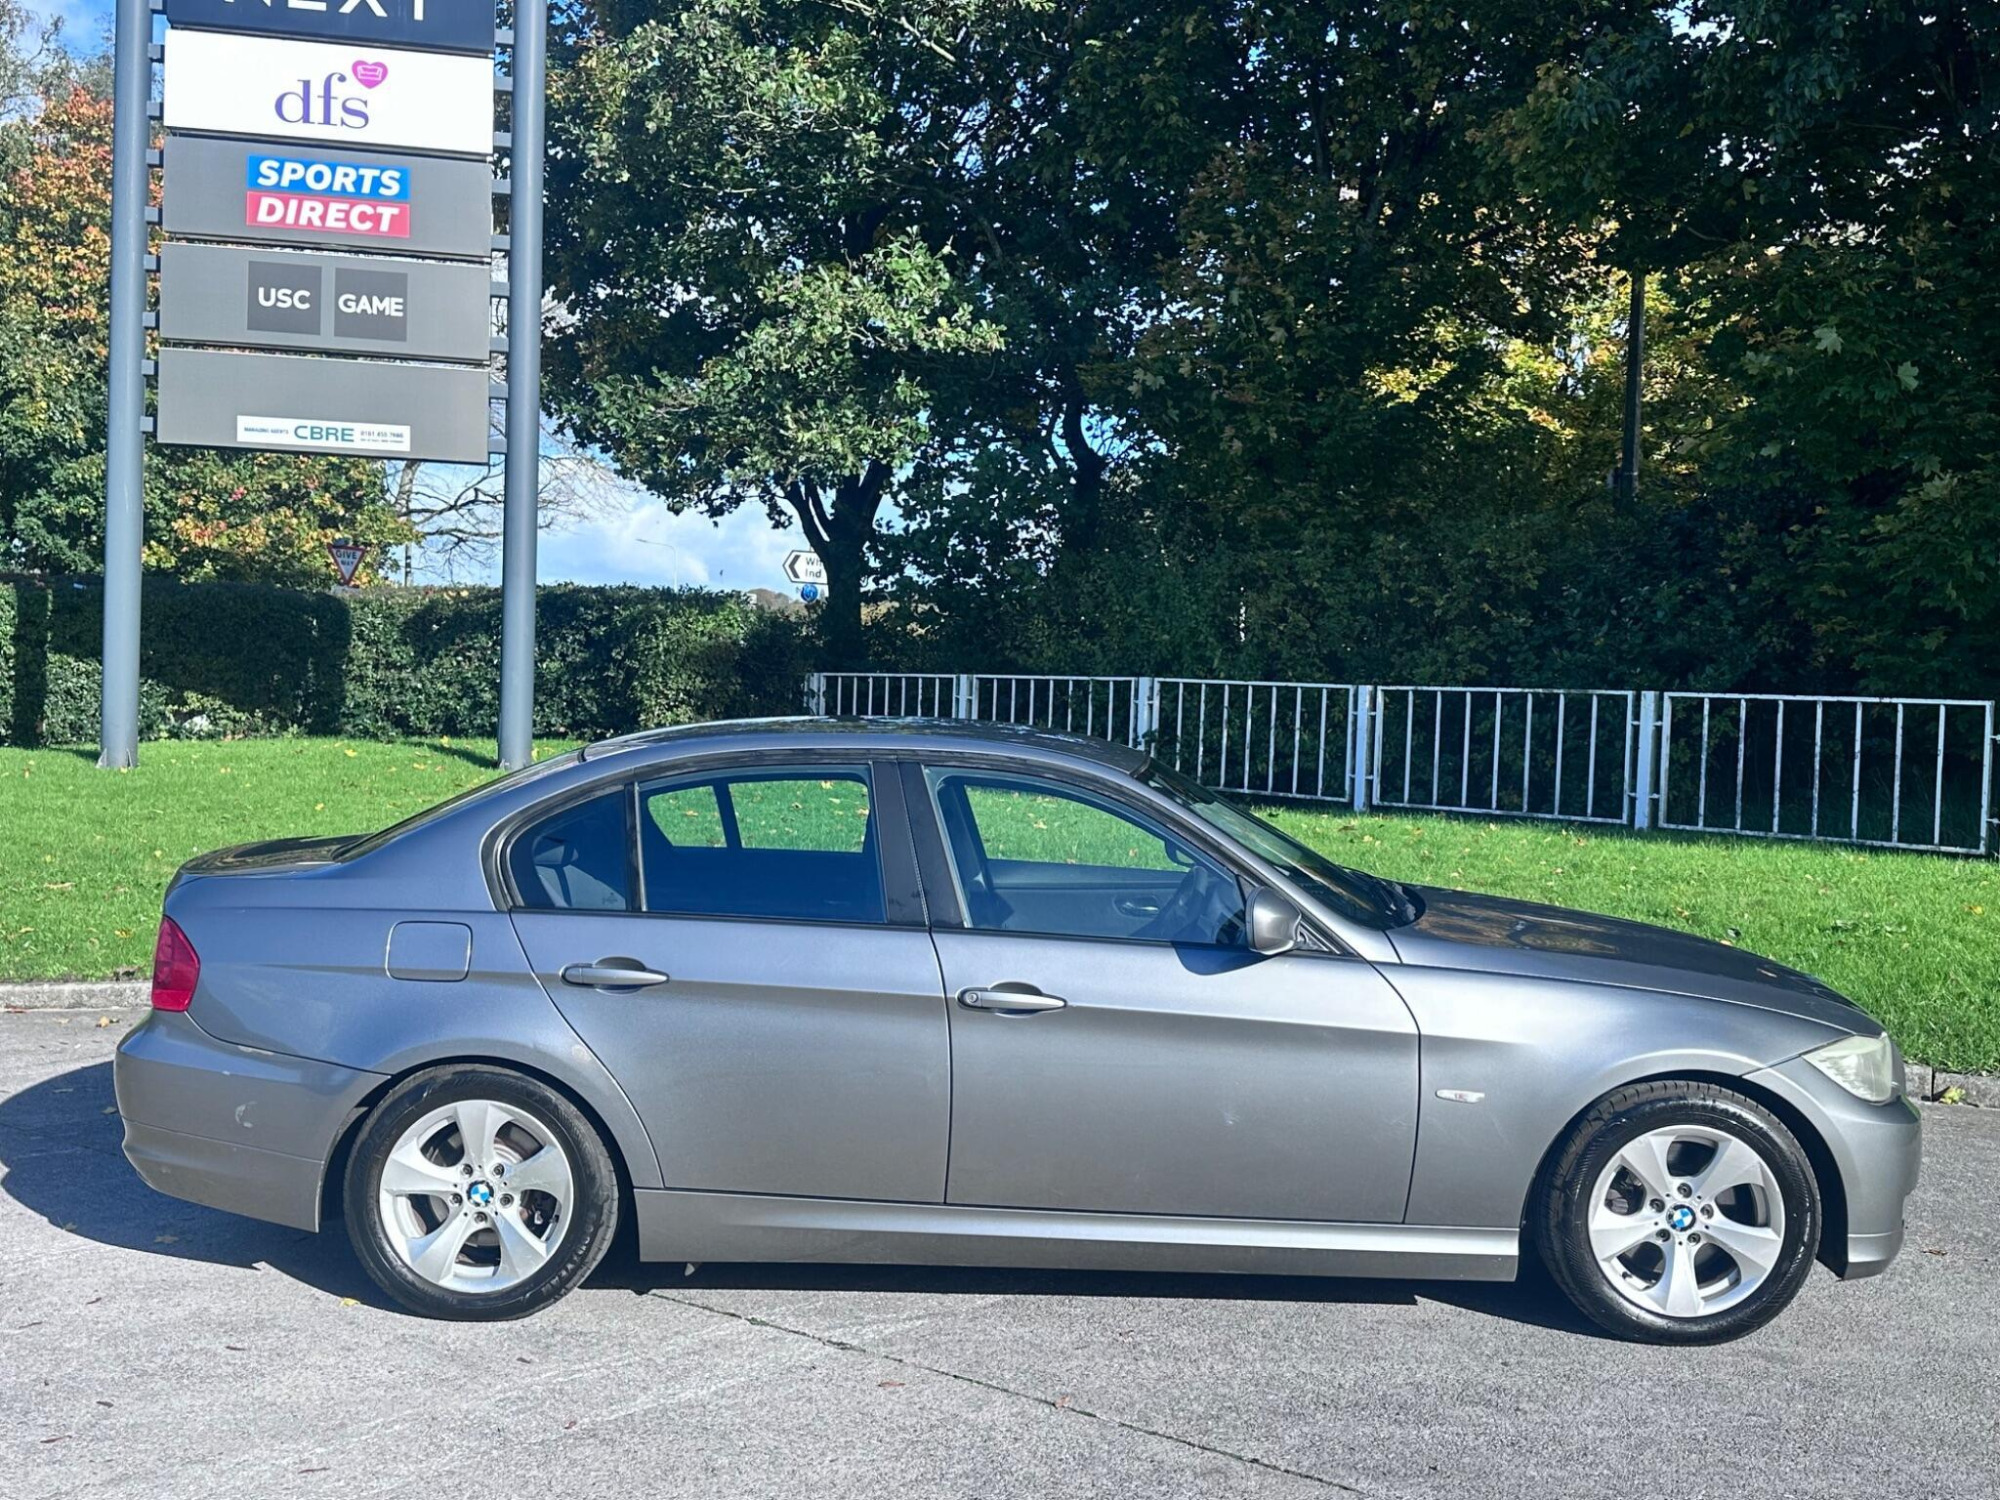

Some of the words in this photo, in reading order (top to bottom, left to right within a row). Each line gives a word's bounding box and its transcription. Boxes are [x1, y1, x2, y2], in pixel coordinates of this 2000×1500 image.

[274, 72, 369, 129] dfs
[257, 159, 402, 197] SPORTS
[256, 196, 400, 233] DIRECT
[258, 287, 311, 310] USC
[338, 293, 404, 317] GAME
[294, 425, 355, 443] CBRE
[336, 550, 357, 560] GIVE
[805, 568, 822, 578] Ind
